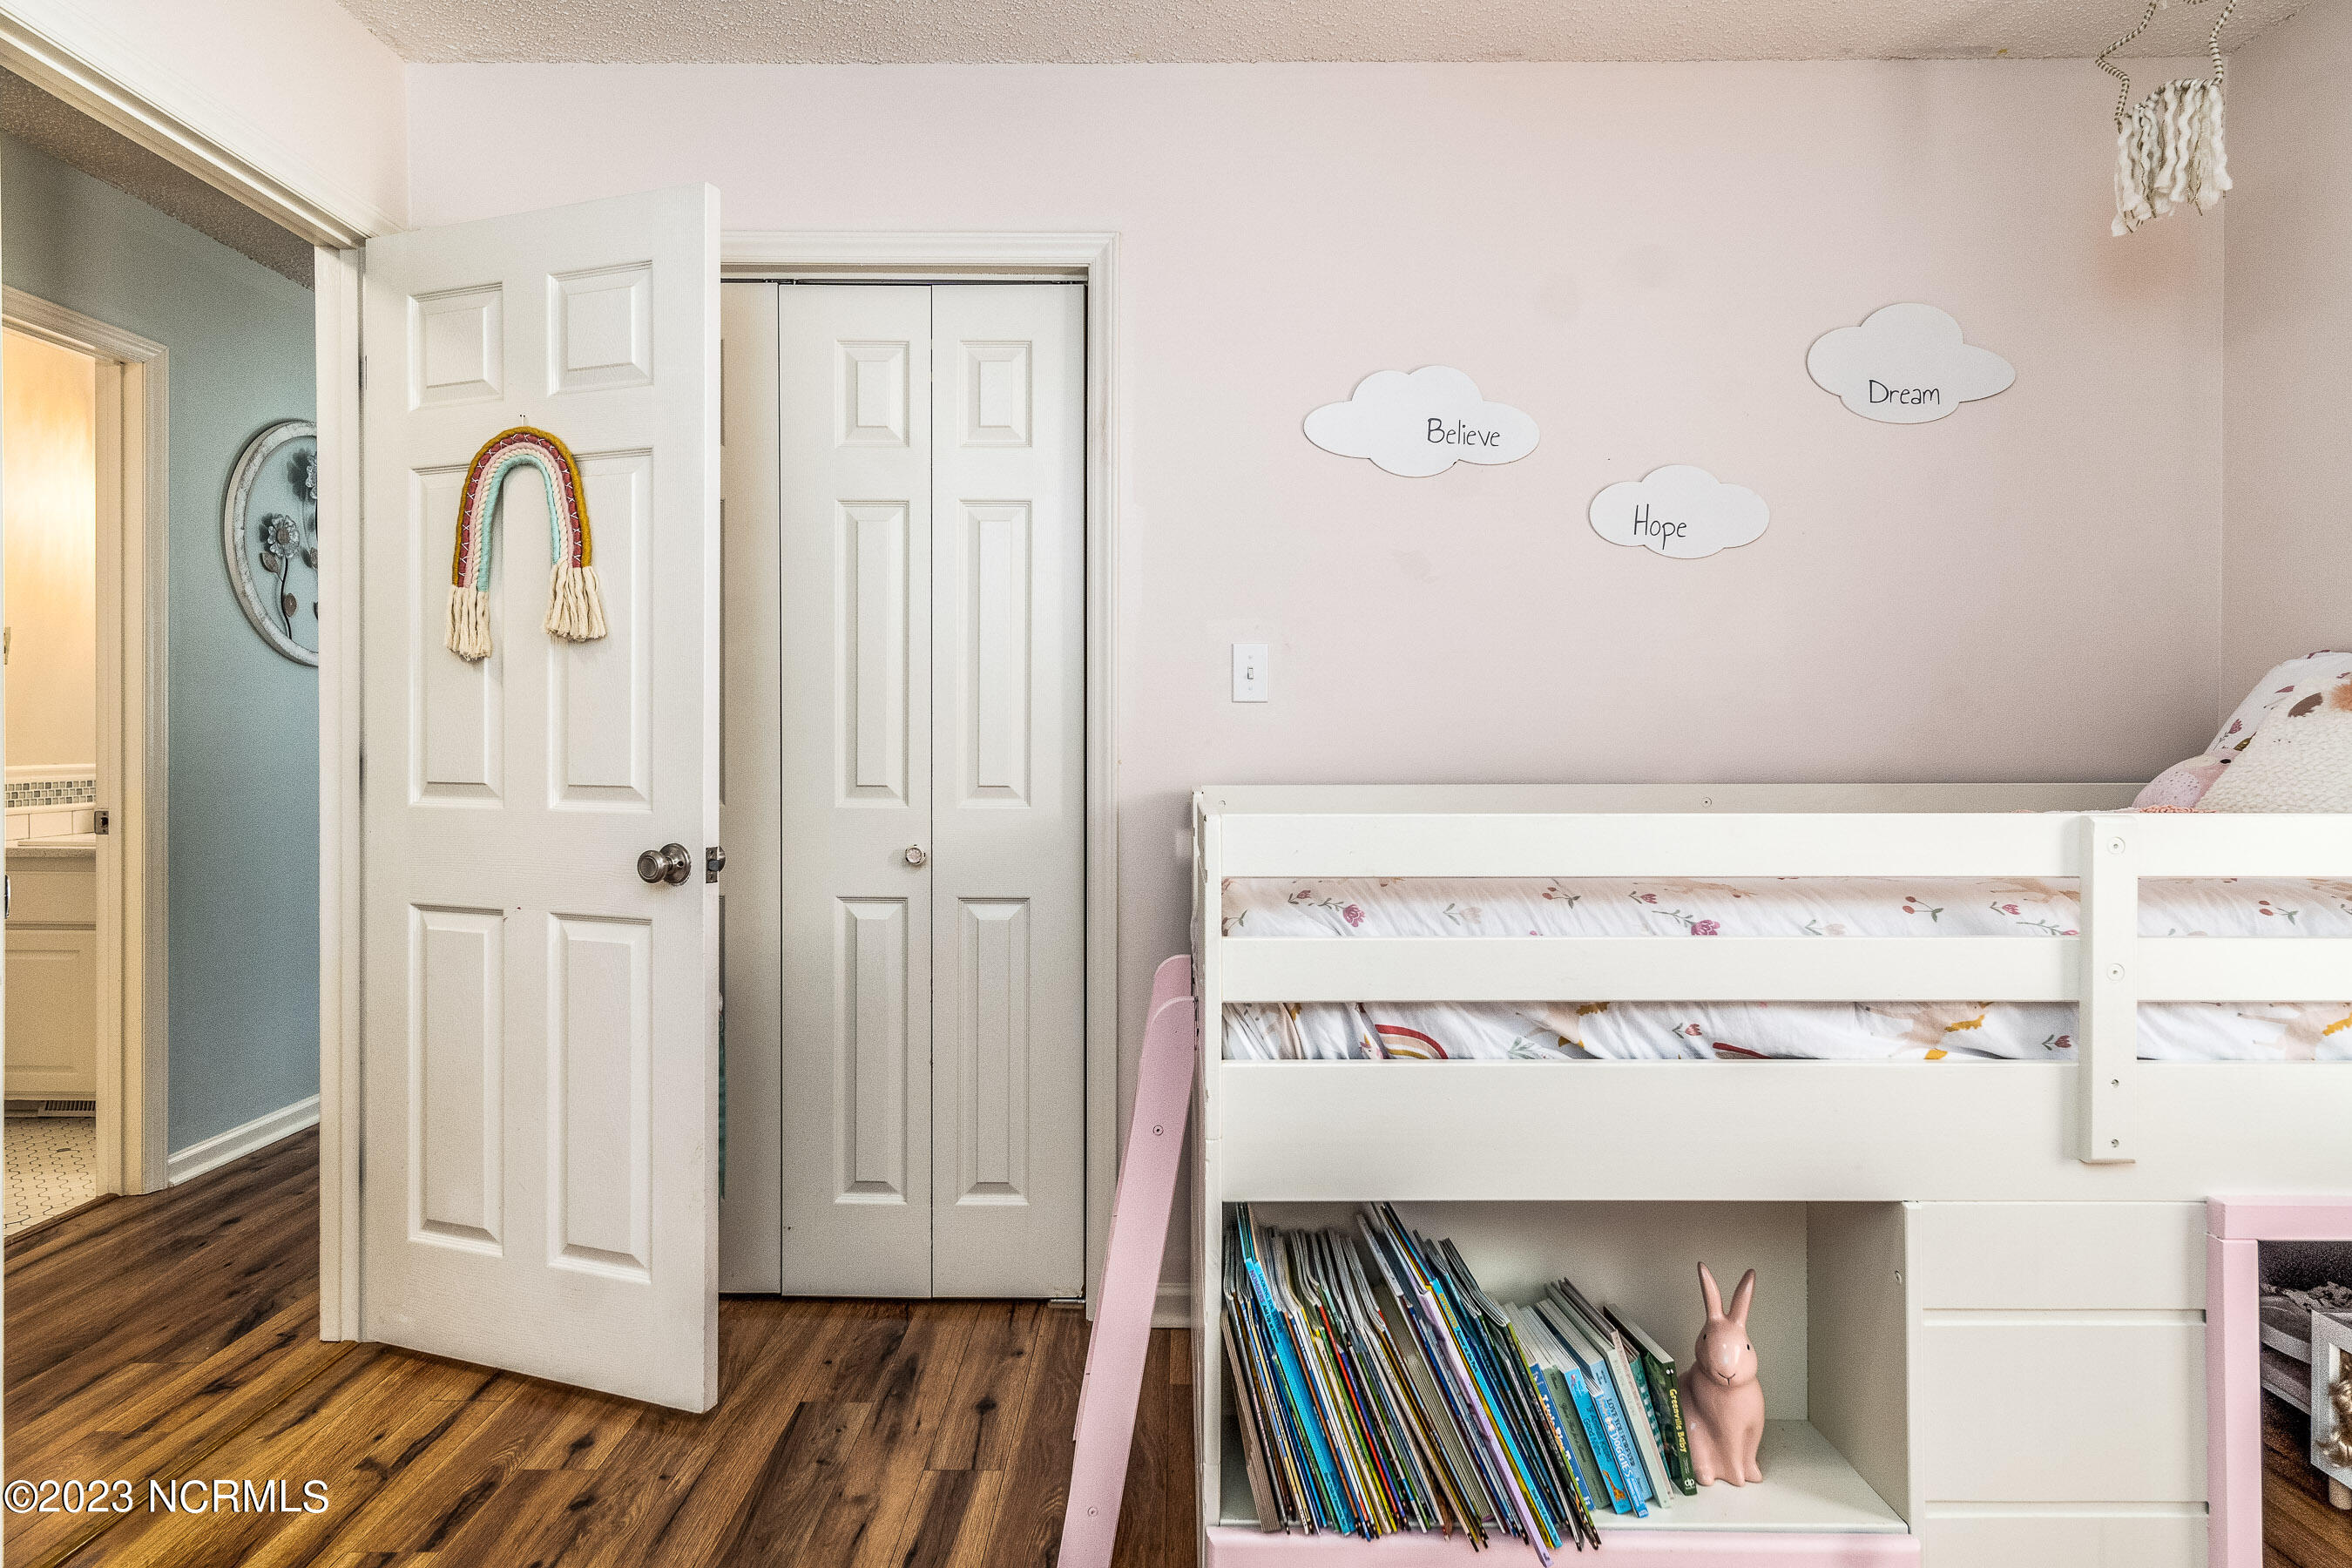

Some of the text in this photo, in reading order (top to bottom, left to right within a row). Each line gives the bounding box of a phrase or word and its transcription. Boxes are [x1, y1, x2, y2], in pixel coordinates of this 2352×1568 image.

[1869, 380, 1939, 404] Dream
[1428, 418, 1499, 446] Believe
[1634, 504, 1686, 550] Hope
[1249, 1269, 1265, 1302] NUMBERS
[1258, 1273, 1270, 1297] LOOKING
[1438, 1292, 1458, 1328] OPPOSITES
[1606, 1398, 1619, 1419] LOVE
[1614, 1419, 1624, 1435] YOU
[1619, 1435, 1636, 1466] FOREVER
[1669, 1388, 1683, 1429] Greenville
[1677, 1431, 1687, 1453] Baby
[1608, 1430, 1634, 1477] DOGGIES
